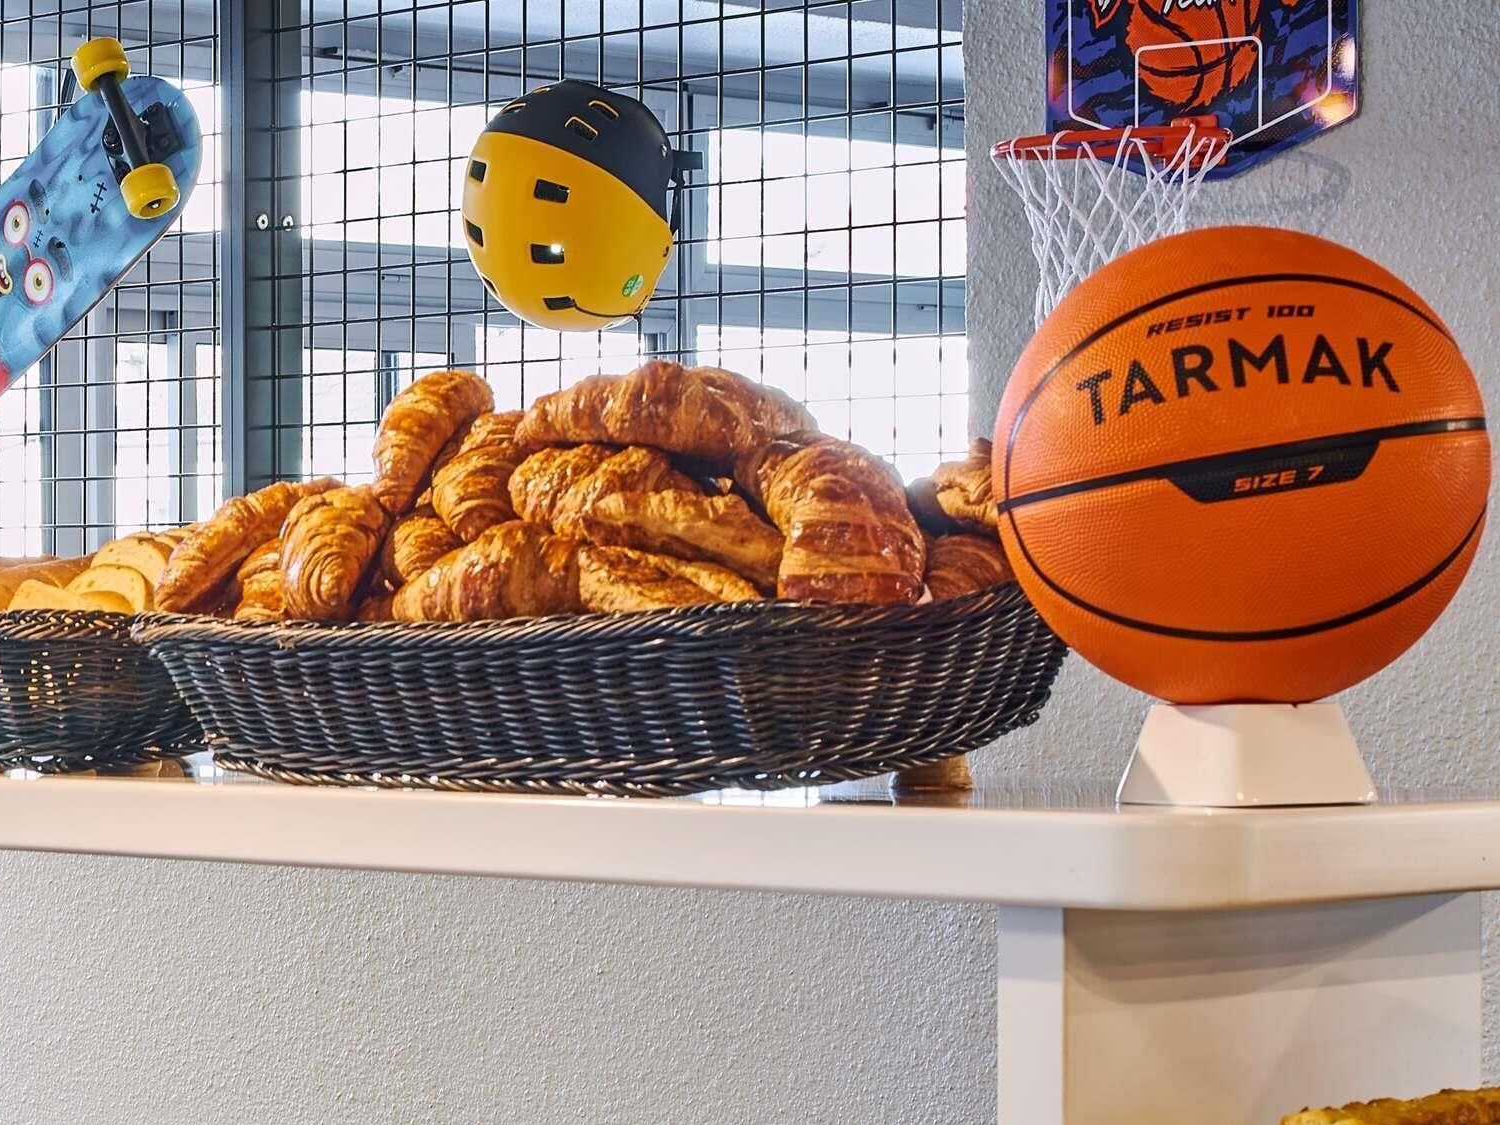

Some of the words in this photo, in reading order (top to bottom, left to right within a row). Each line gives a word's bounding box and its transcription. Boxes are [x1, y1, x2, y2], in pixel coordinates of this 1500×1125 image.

[1146, 308, 1251, 338] RESIST
[1267, 305, 1316, 319] 100
[1075, 333, 1401, 426] TARMAK
[1234, 470, 1296, 493] SIZE
[1308, 465, 1325, 483] 7
